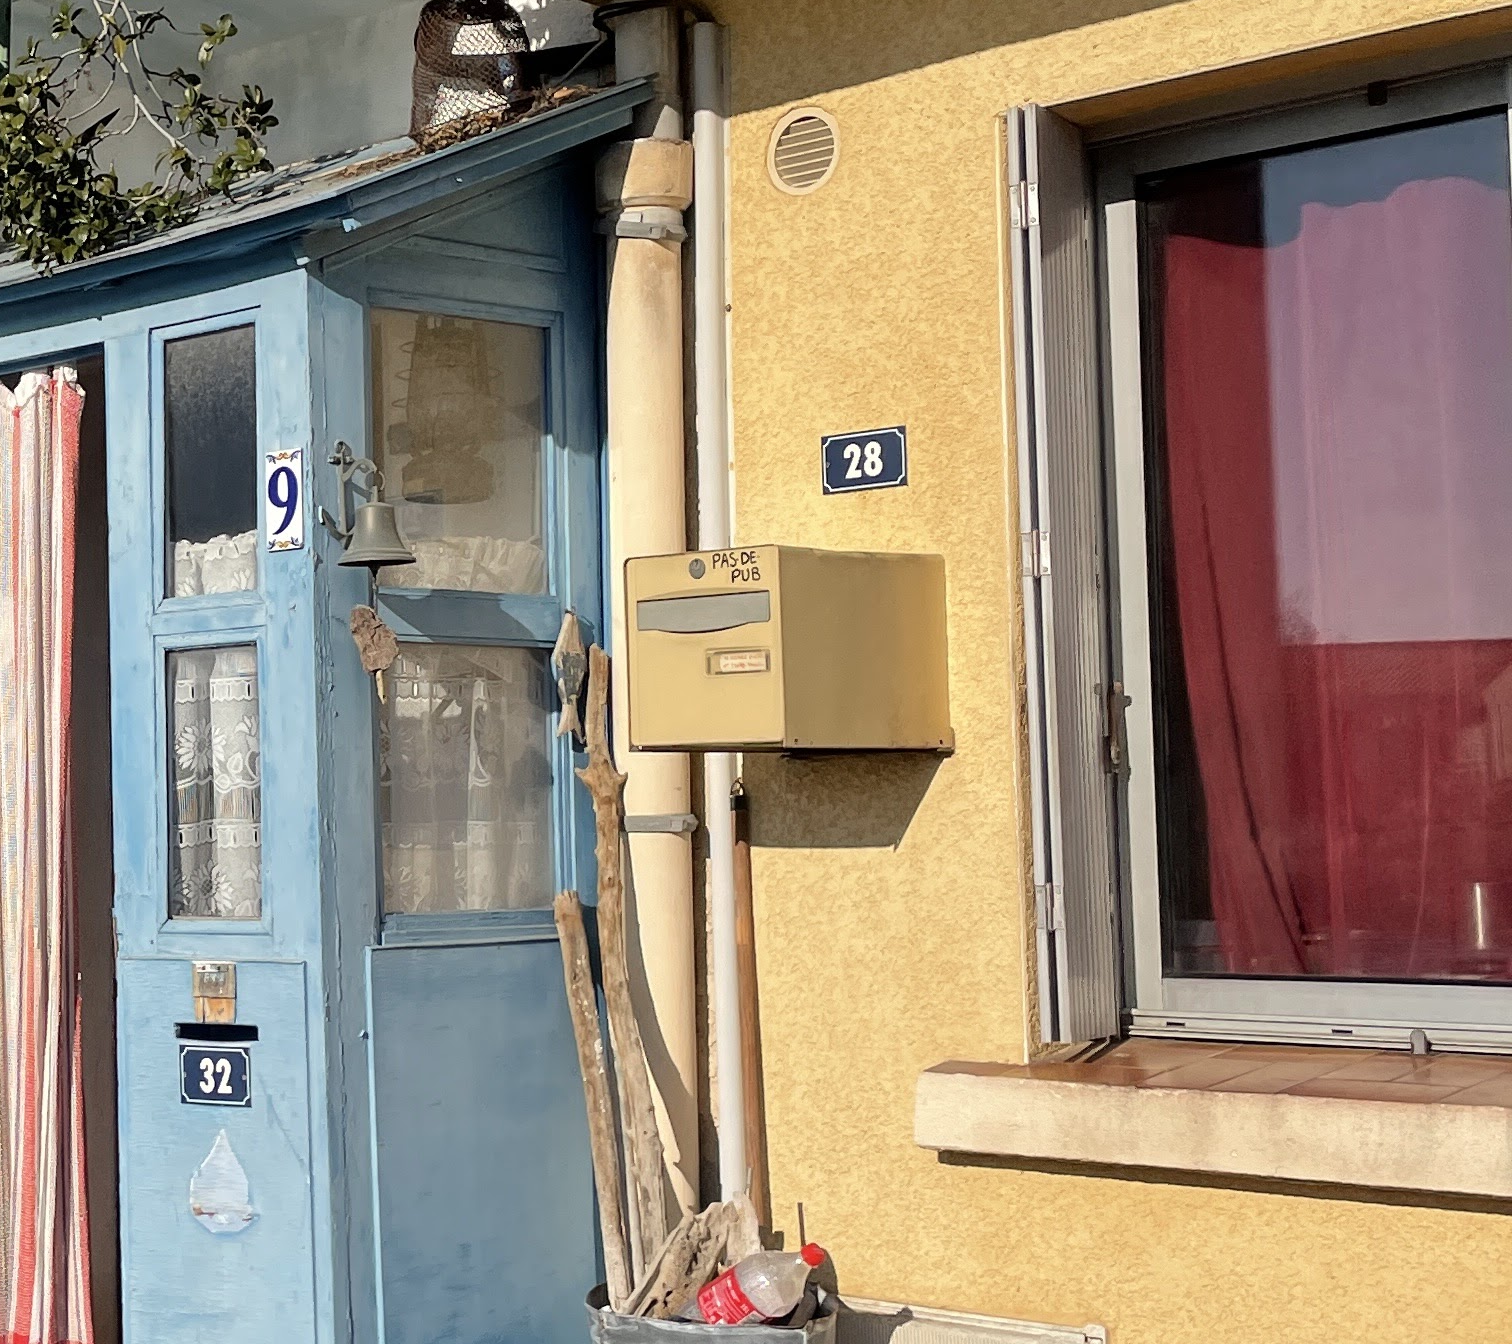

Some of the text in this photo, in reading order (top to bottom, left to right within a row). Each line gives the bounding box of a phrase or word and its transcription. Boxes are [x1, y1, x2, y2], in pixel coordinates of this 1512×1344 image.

[843, 441, 883, 479] 28
[268, 466, 299, 535] 9
[712, 551, 757, 569] PAS DE
[731, 567, 761, 583] PUB
[199, 1057, 233, 1094] 32
